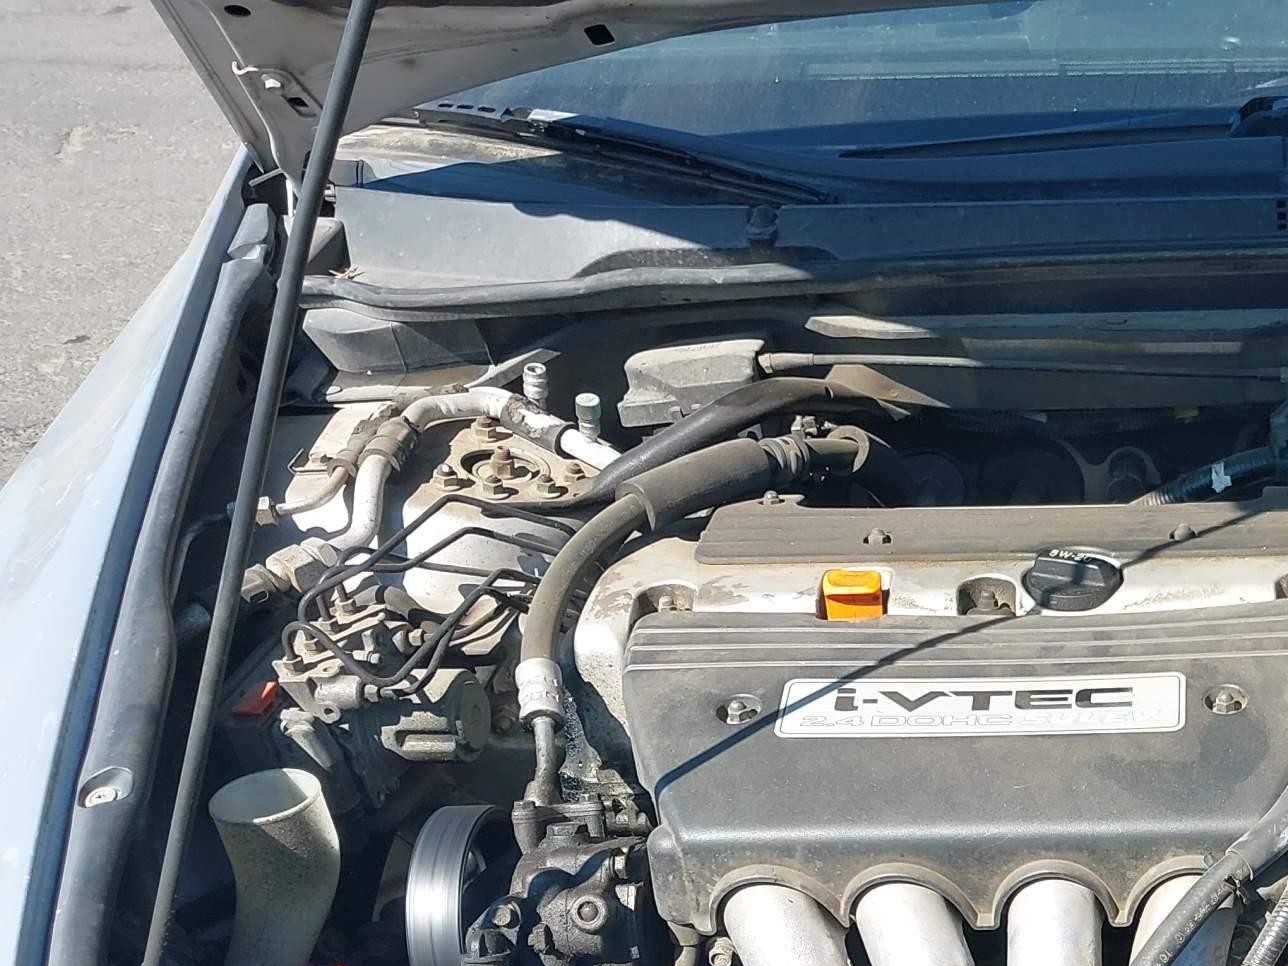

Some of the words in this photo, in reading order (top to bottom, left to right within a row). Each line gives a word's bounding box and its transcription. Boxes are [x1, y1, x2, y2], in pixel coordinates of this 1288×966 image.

[834, 686, 1134, 712] i-VTEC
[799, 715, 865, 727] 2.4
[870, 713, 1013, 727] DOHC
[1021, 707, 1163, 725] SULEV
